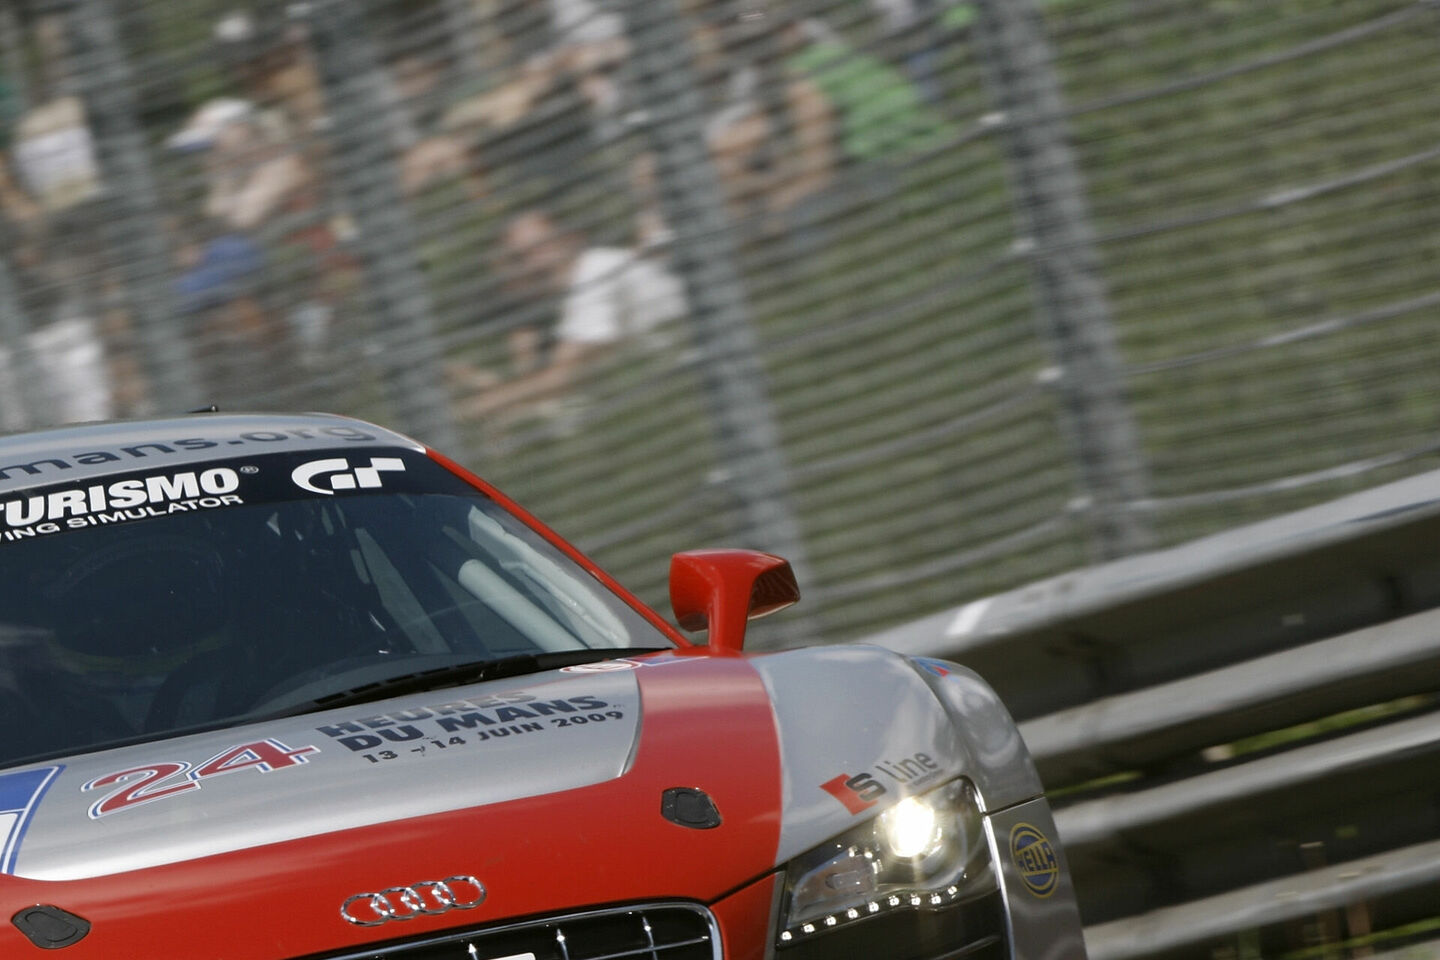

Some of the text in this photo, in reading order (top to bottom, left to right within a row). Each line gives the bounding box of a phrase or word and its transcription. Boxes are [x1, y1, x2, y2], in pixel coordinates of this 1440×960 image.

[66, 494, 245, 530] SIMULATOR
[315, 691, 538, 737] HEURES
[337, 695, 610, 752] DU MANS
[362, 750, 399, 764] 13
[431, 736, 467, 750] 14
[479, 722, 545, 741] JUIN
[551, 711, 625, 729] 2009
[80, 738, 321, 820] 24
[876, 752, 938, 784] line
